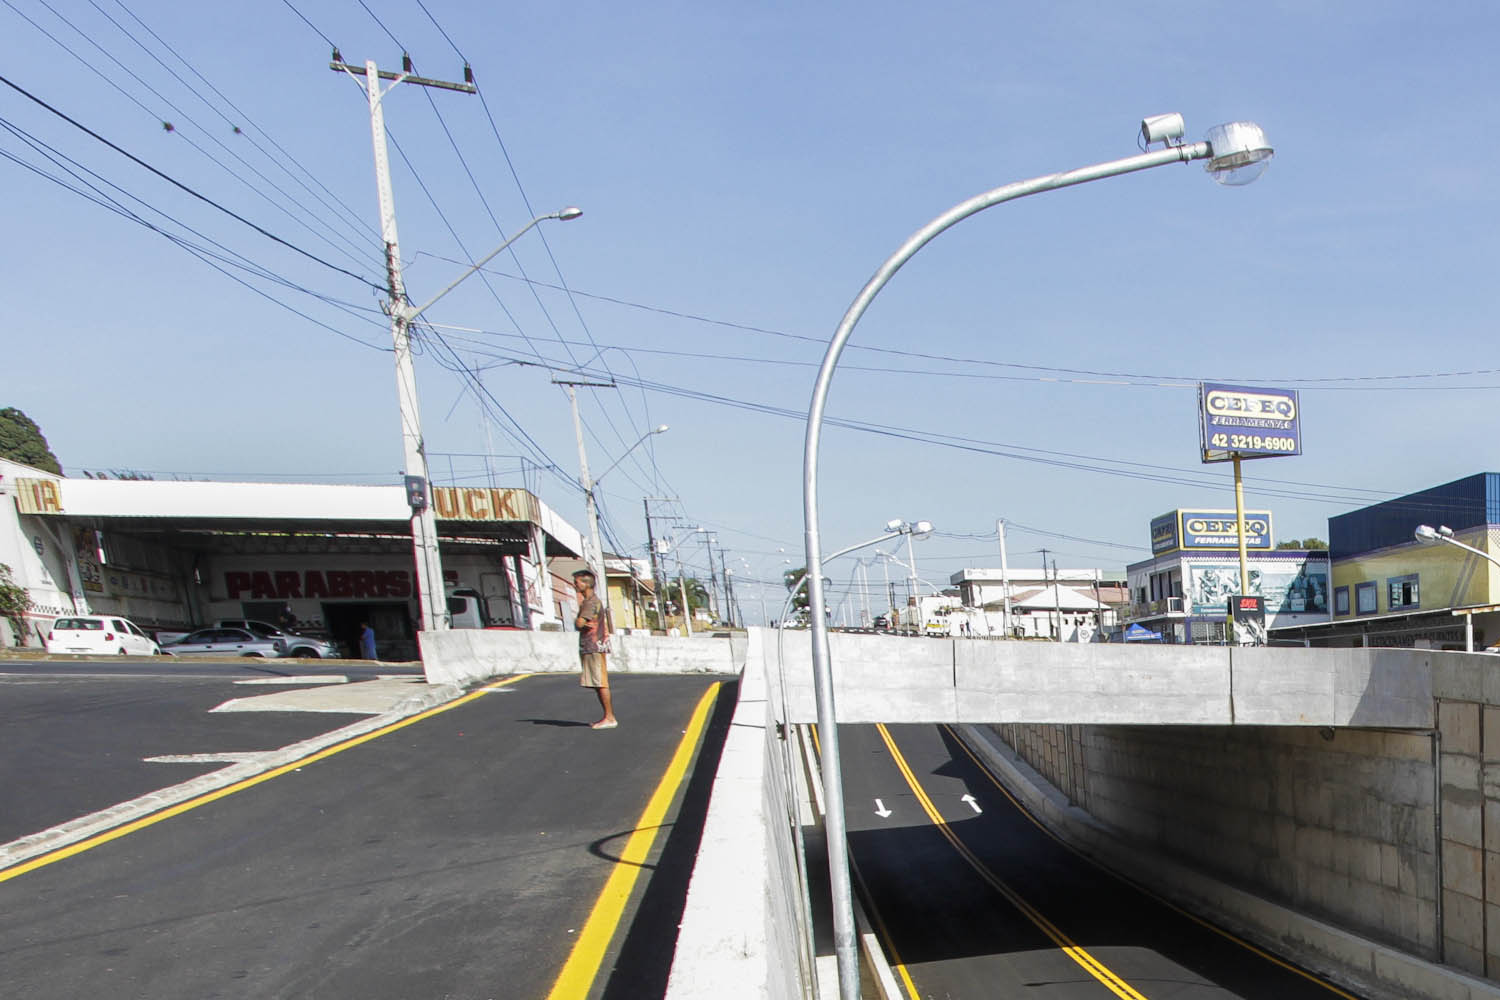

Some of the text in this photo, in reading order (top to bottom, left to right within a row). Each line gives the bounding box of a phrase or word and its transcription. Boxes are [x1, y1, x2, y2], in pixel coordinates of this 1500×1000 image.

[1211, 433, 1295, 451] 42 3219-6900
[1194, 536, 1262, 545] FERRAMETAS
